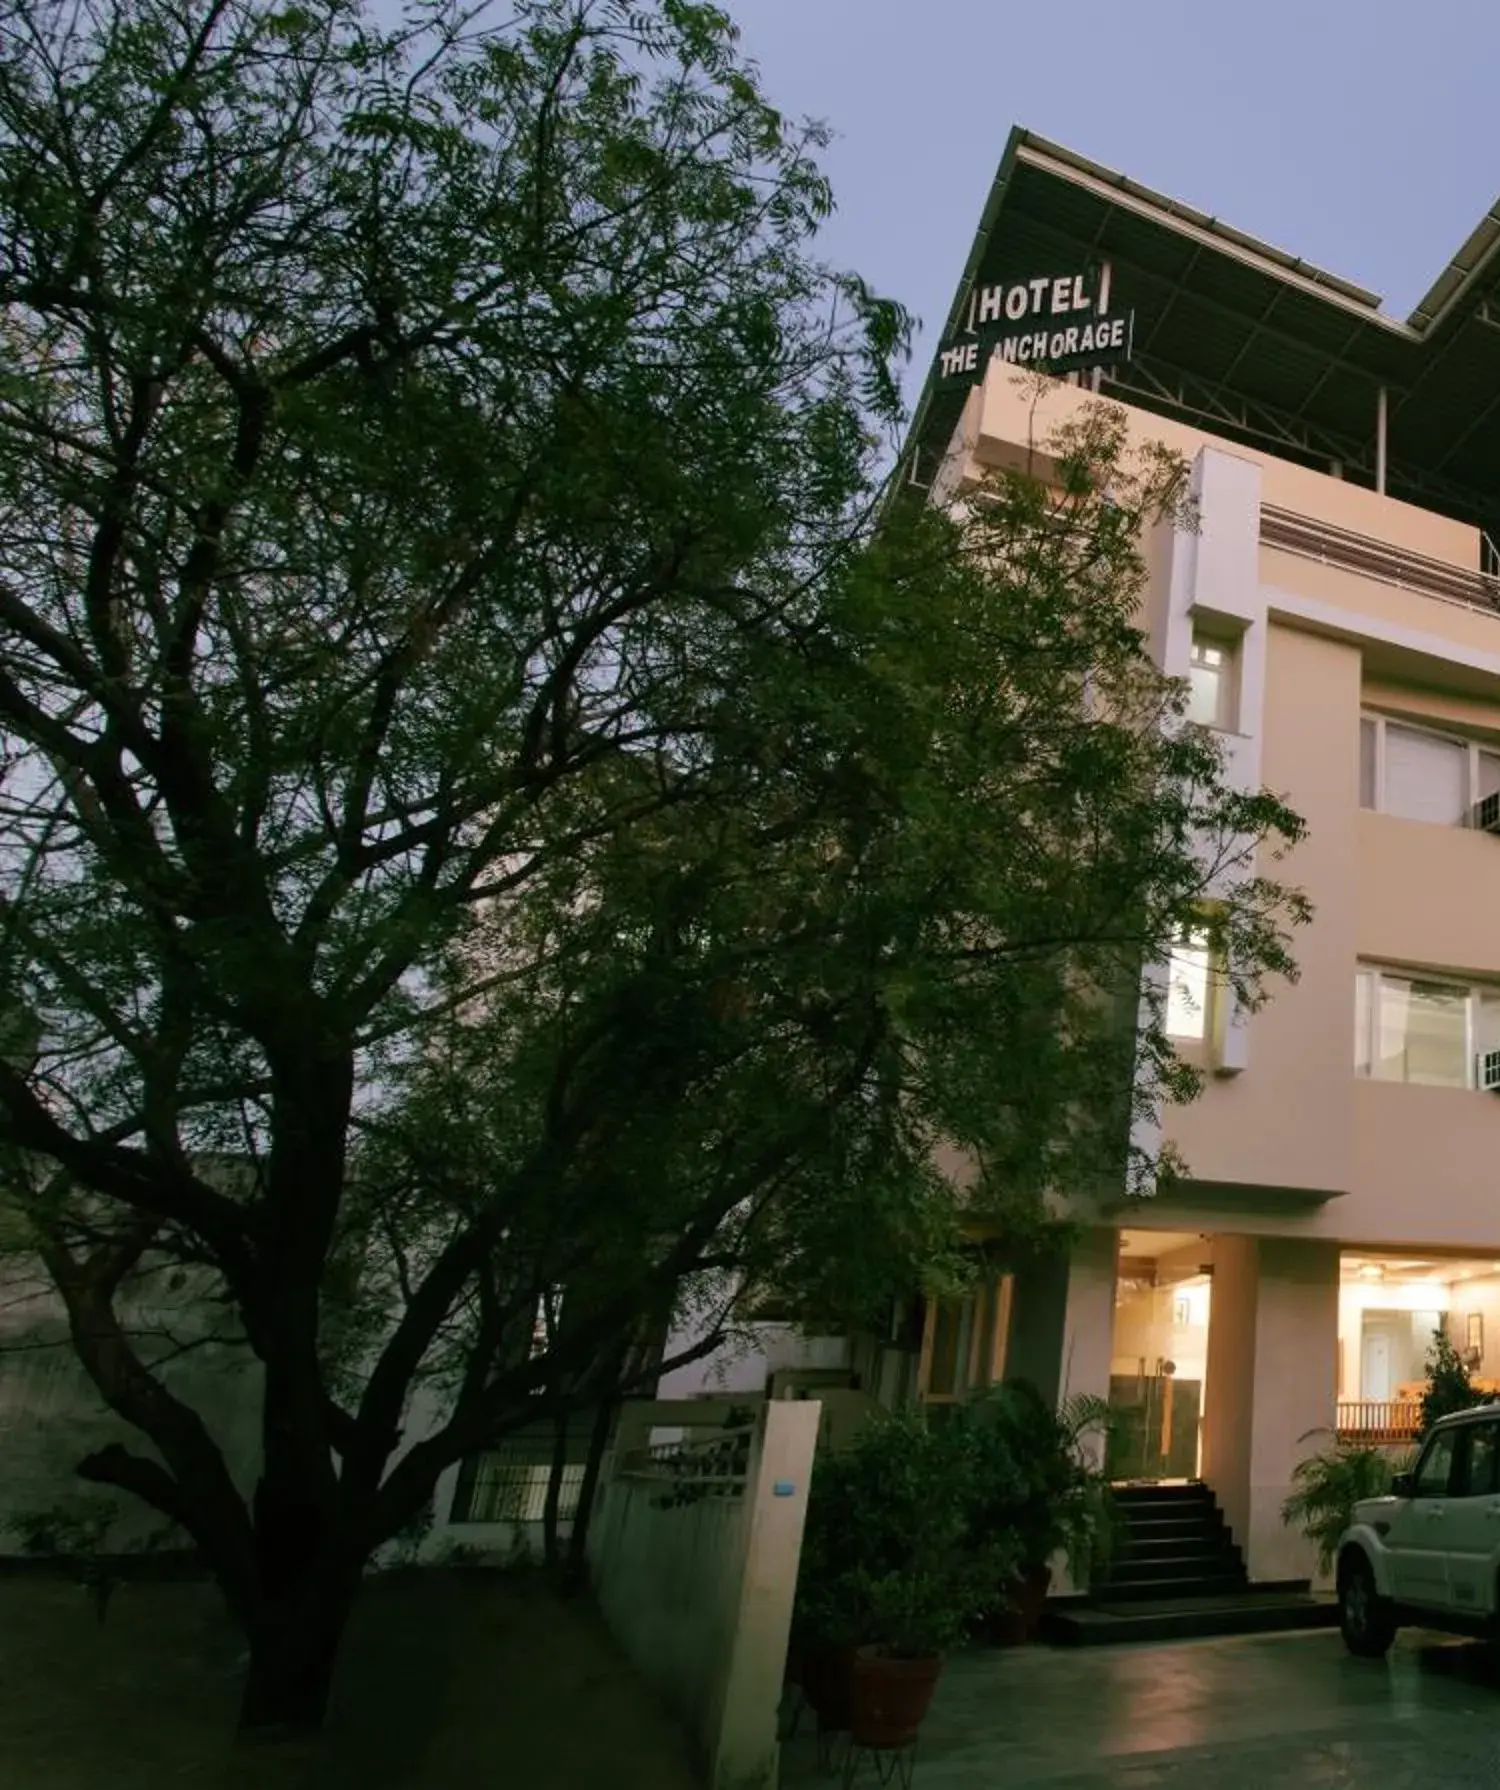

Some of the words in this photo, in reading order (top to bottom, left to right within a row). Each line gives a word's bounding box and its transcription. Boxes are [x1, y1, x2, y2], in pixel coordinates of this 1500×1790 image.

[979, 275, 1091, 323] HOTEL
[940, 342, 979, 379] THE
[991, 319, 1125, 363] ANCHORAGE
